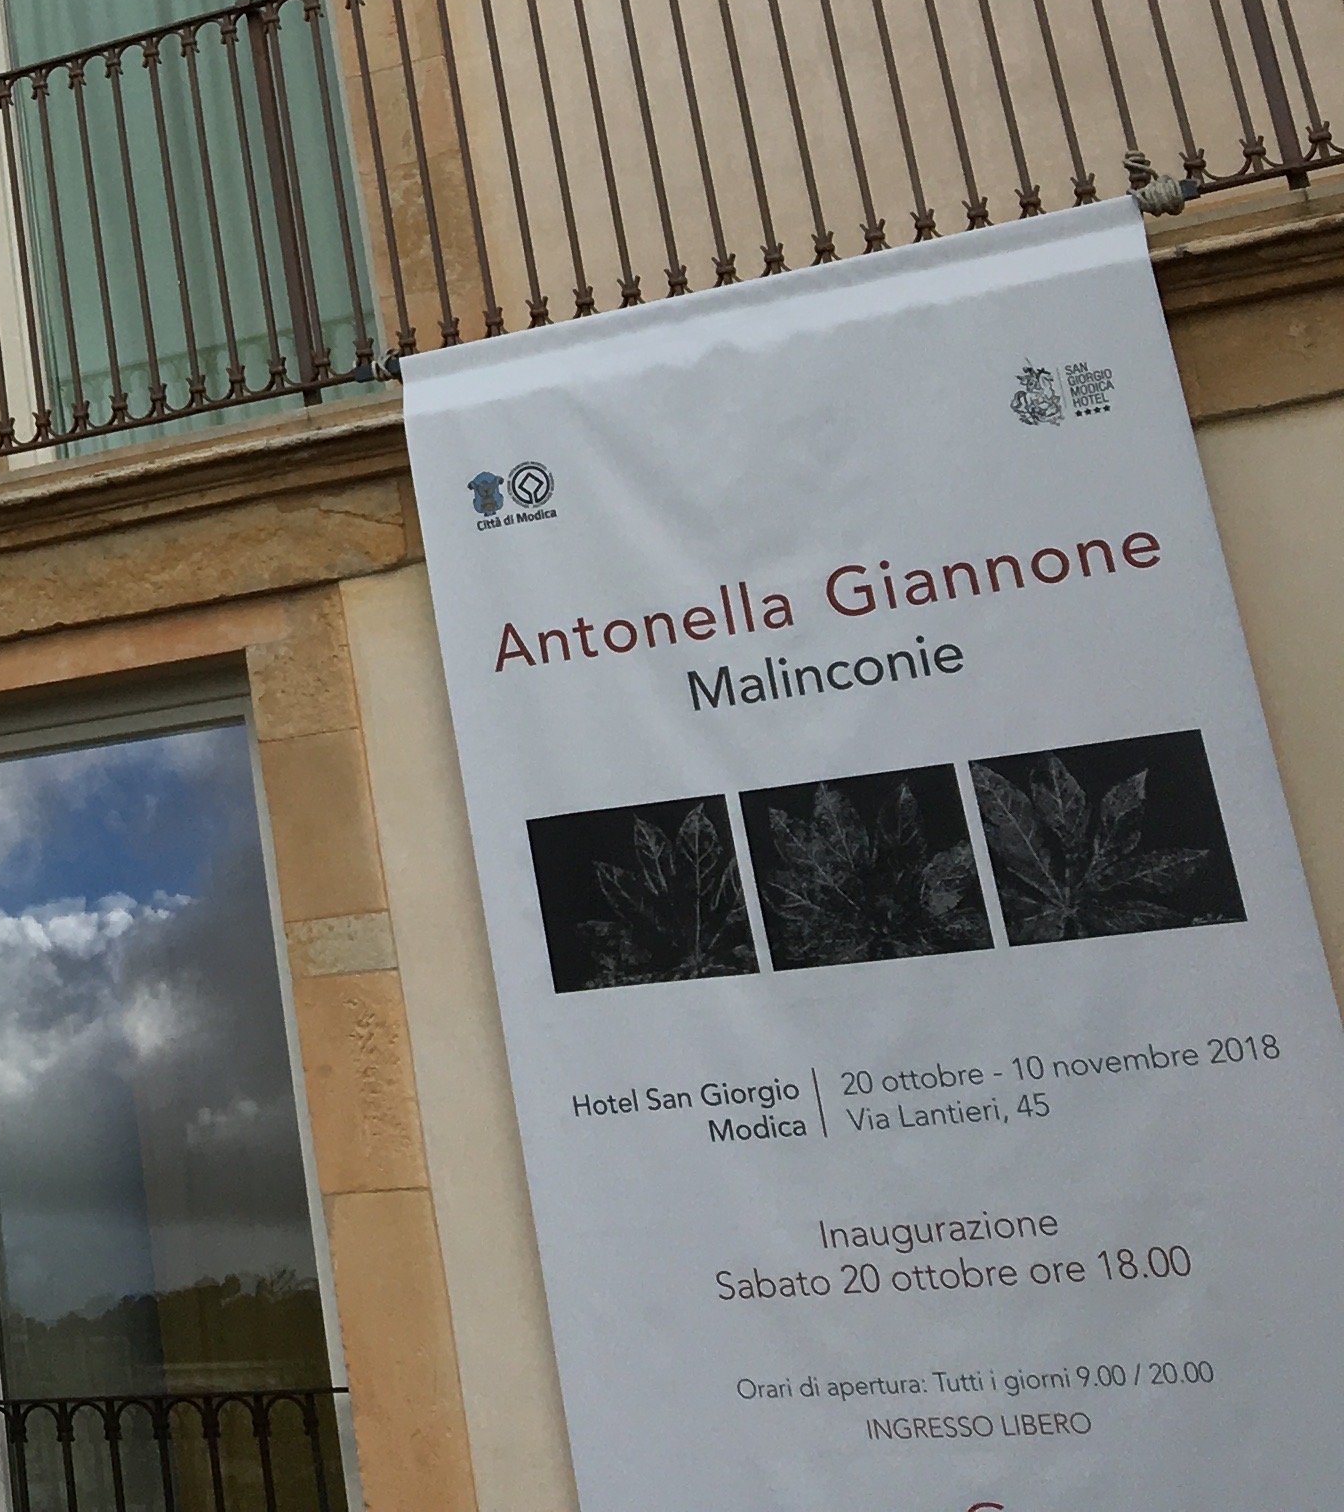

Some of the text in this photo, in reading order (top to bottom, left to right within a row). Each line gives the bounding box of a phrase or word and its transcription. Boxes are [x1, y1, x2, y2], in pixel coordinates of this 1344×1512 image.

[1064, 362, 1088, 375] SAN
[1067, 368, 1112, 386] GIORGIO
[1070, 380, 1114, 397] MODICA
[1072, 393, 1109, 408] HOTEL
[476, 508, 557, 531] Città di Modica
[494, 530, 1161, 671] Antonella Giannone
[687, 635, 964, 711] Malinconie
[840, 1070, 874, 1096] 20
[881, 1063, 985, 1093] ottobre
[1012, 1055, 1045, 1081] 10
[1053, 1044, 1199, 1078] novembre
[1207, 1034, 1281, 1065] 2018
[572, 1078, 800, 1117] Hotel San Giorgio
[845, 1092, 1050, 1132] Via Lantieri, 45
[708, 1115, 807, 1143] Modica
[819, 1210, 1059, 1253] Inaugurazione
[715, 1245, 1192, 1301] Sabato 20 ottobre ore 18.00
[736, 1377, 794, 1400] Orari
[799, 1375, 820, 1398] di
[827, 1375, 928, 1402] apertura:
[932, 1370, 983, 1393] Tutti
[990, 1368, 997, 1391] i
[1004, 1366, 1071, 1397] giorni
[1075, 1364, 1127, 1388] 9.00
[1148, 1360, 1214, 1386] 20.00
[865, 1412, 1092, 1441] INGRESSO LIBERO
